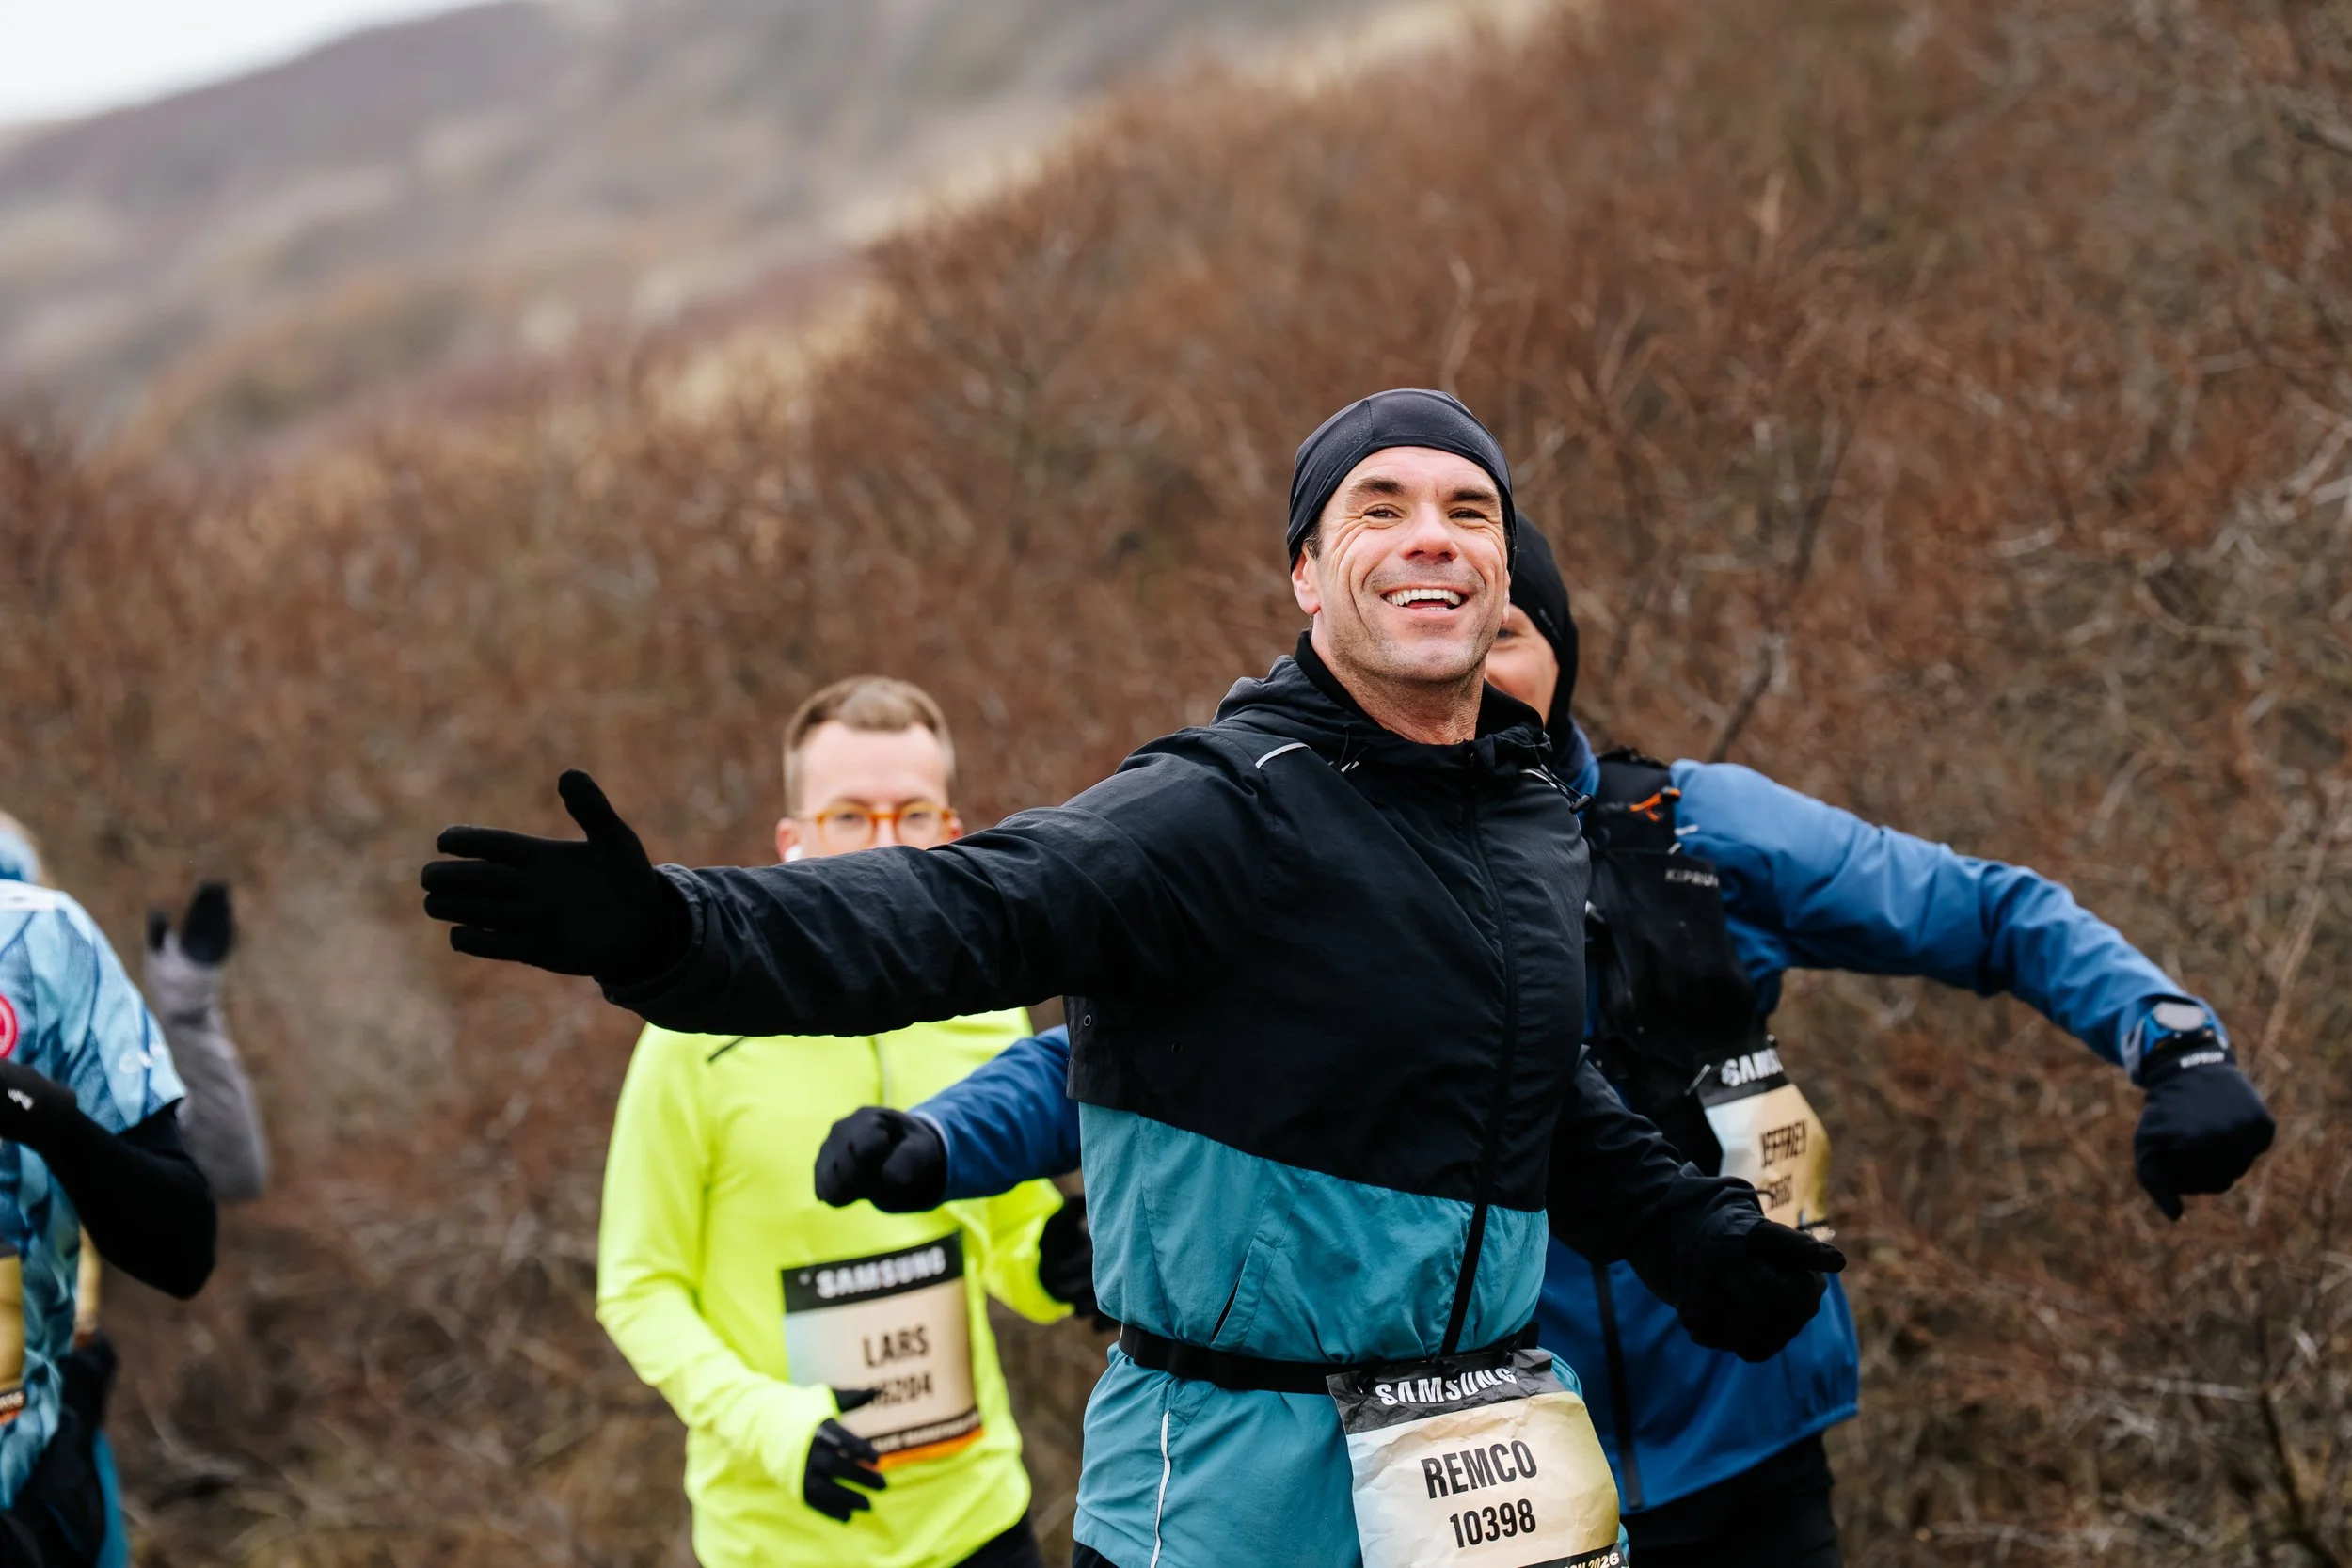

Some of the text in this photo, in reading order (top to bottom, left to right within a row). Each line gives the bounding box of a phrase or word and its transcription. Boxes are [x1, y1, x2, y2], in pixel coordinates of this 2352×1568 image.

[816, 1246, 946, 1298] SAMSUNG
[862, 1325, 931, 1368] LARS
[1375, 1367, 1517, 1406] SAMSUNG
[1421, 1440, 1538, 1499] REMCO
[1449, 1498, 1537, 1548] 10398
